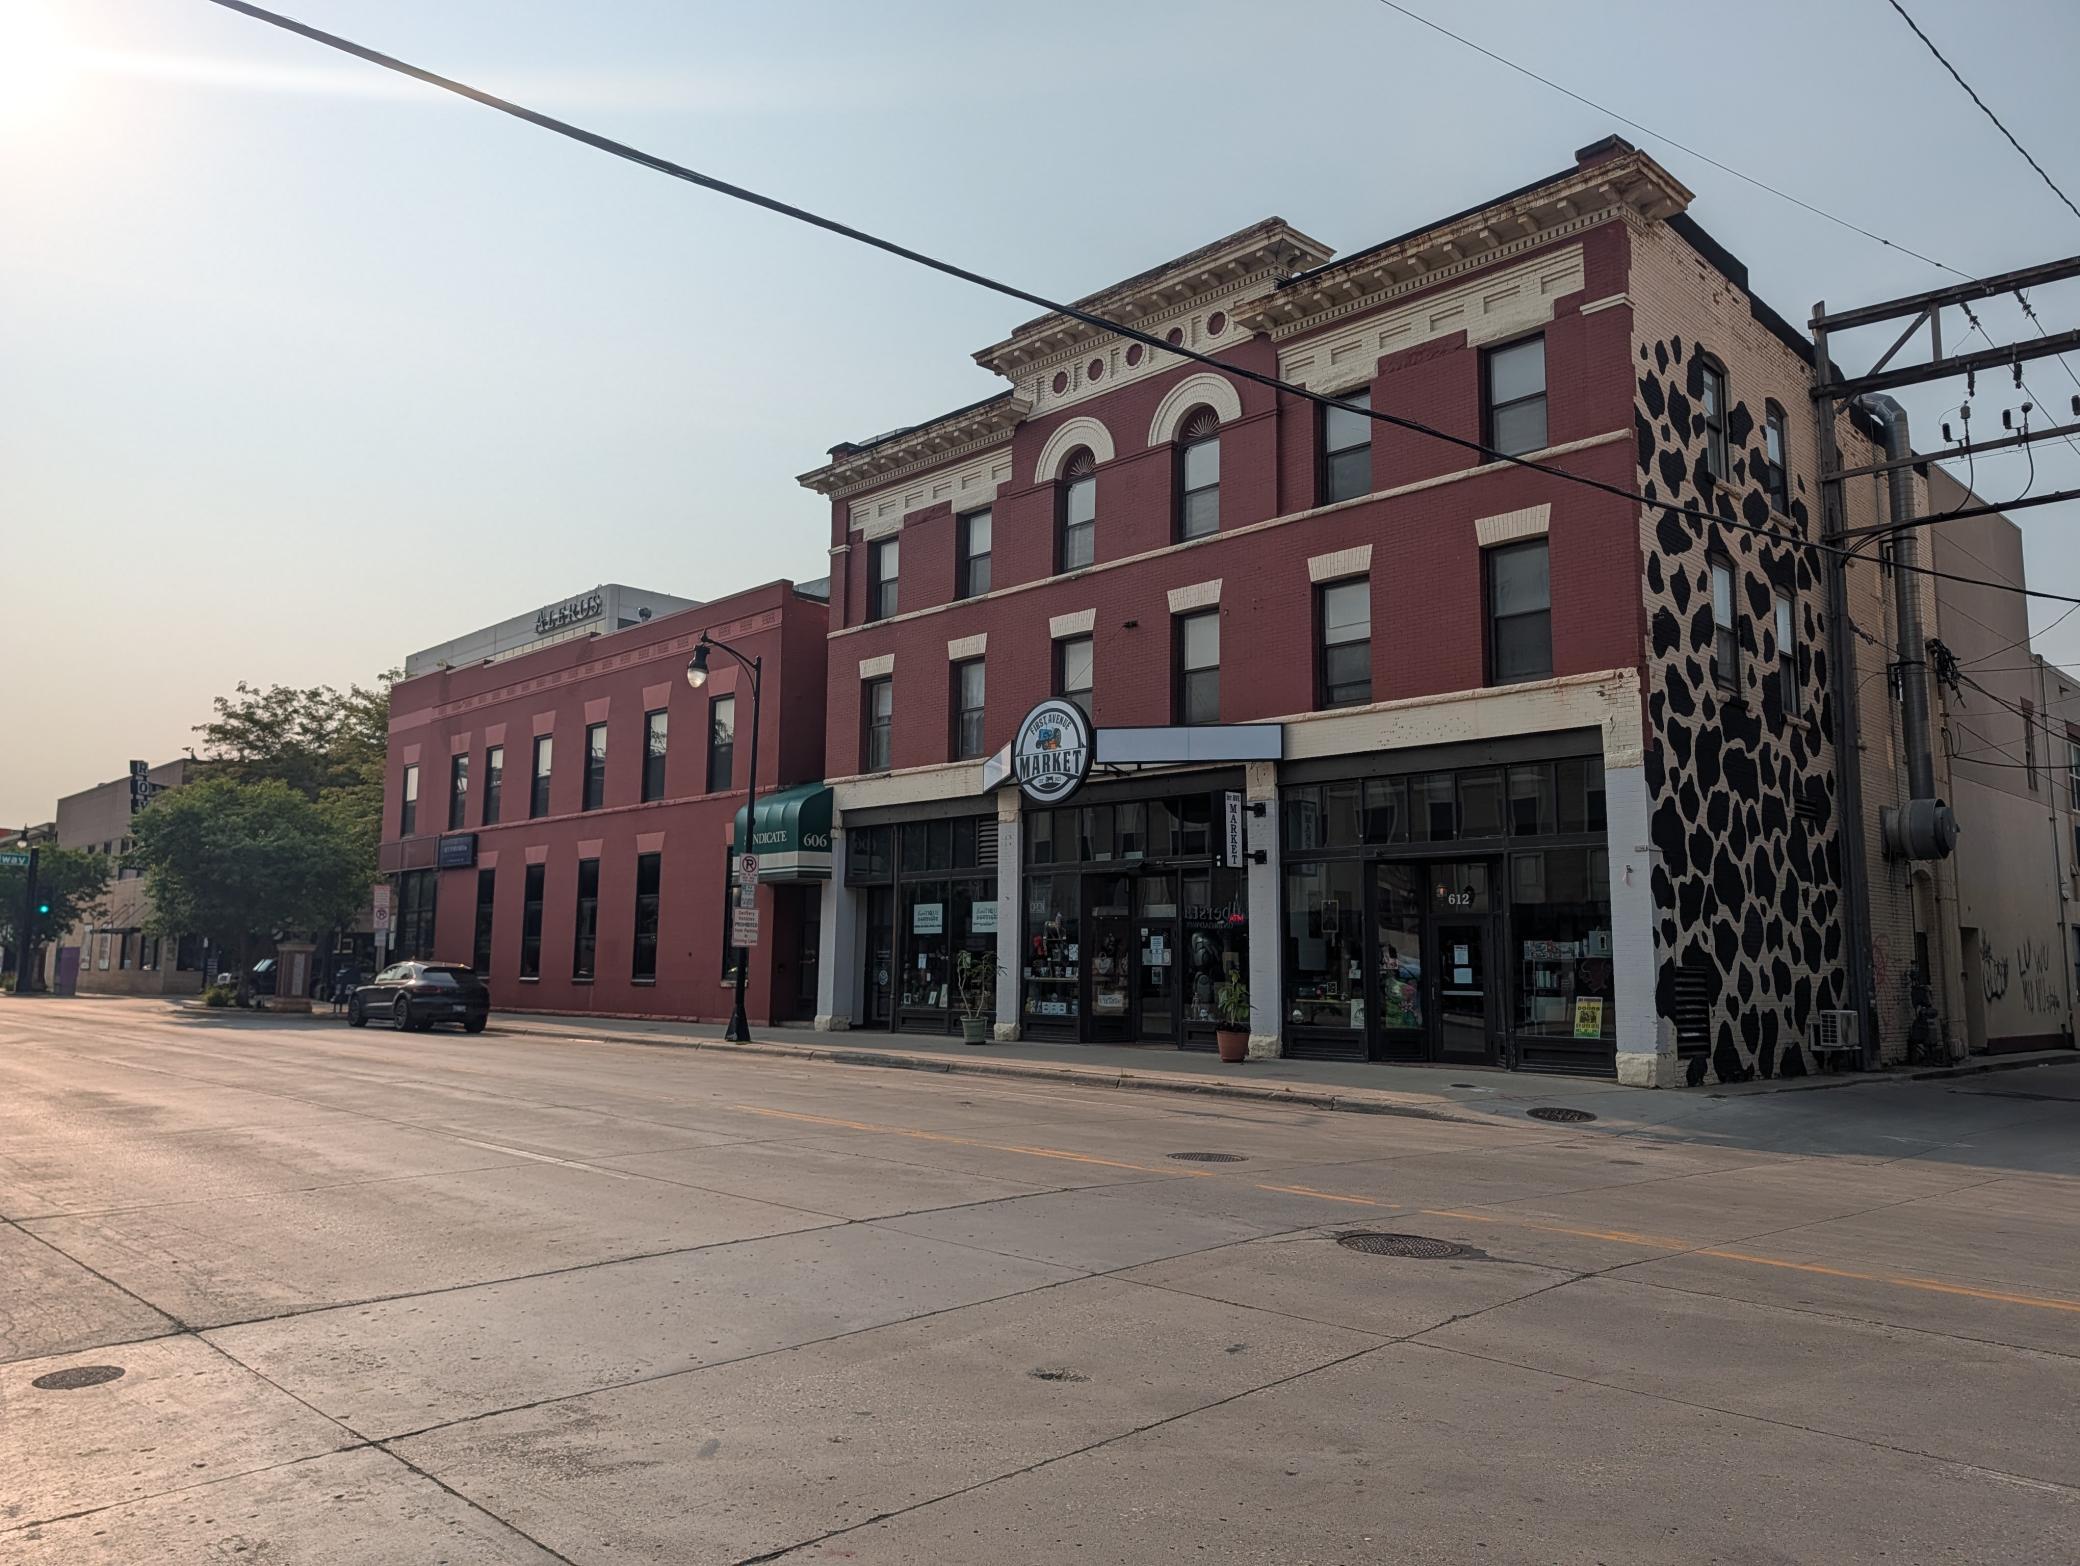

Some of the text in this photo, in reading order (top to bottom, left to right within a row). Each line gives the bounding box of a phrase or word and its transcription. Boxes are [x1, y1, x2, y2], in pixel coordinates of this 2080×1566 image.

[535, 594, 602, 634] ALERUS
[1029, 713, 1072, 736] FIRST AVENUE
[1019, 750, 1082, 781] MARKET
[744, 830, 788, 846] NDICATE
[804, 833, 828, 847] 606
[1229, 803, 1238, 865] MARKET
[0, 855, 26, 865] way
[1448, 893, 1470, 905] 612
